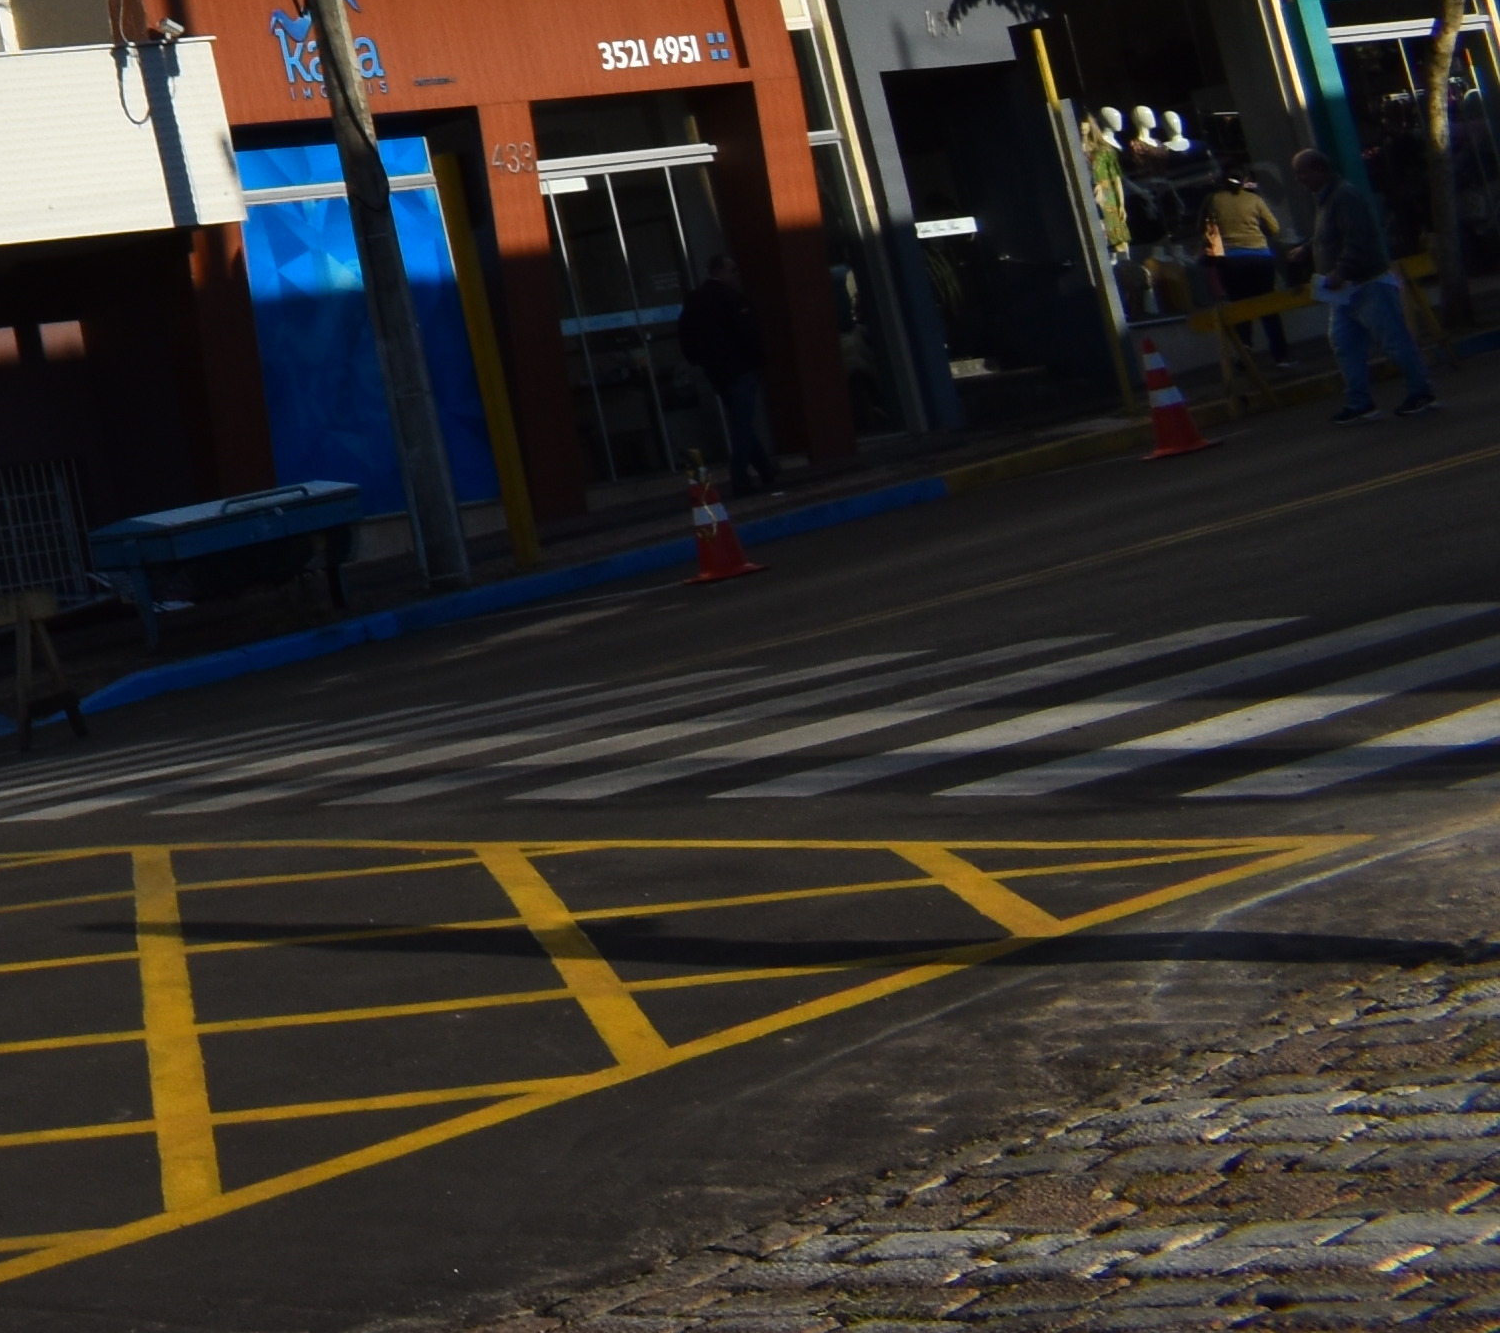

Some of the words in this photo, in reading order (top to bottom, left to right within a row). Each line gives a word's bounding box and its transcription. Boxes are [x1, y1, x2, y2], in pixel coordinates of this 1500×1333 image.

[597, 38, 651, 71] 3521
[652, 34, 702, 65] 4951
[491, 141, 535, 174] 433
